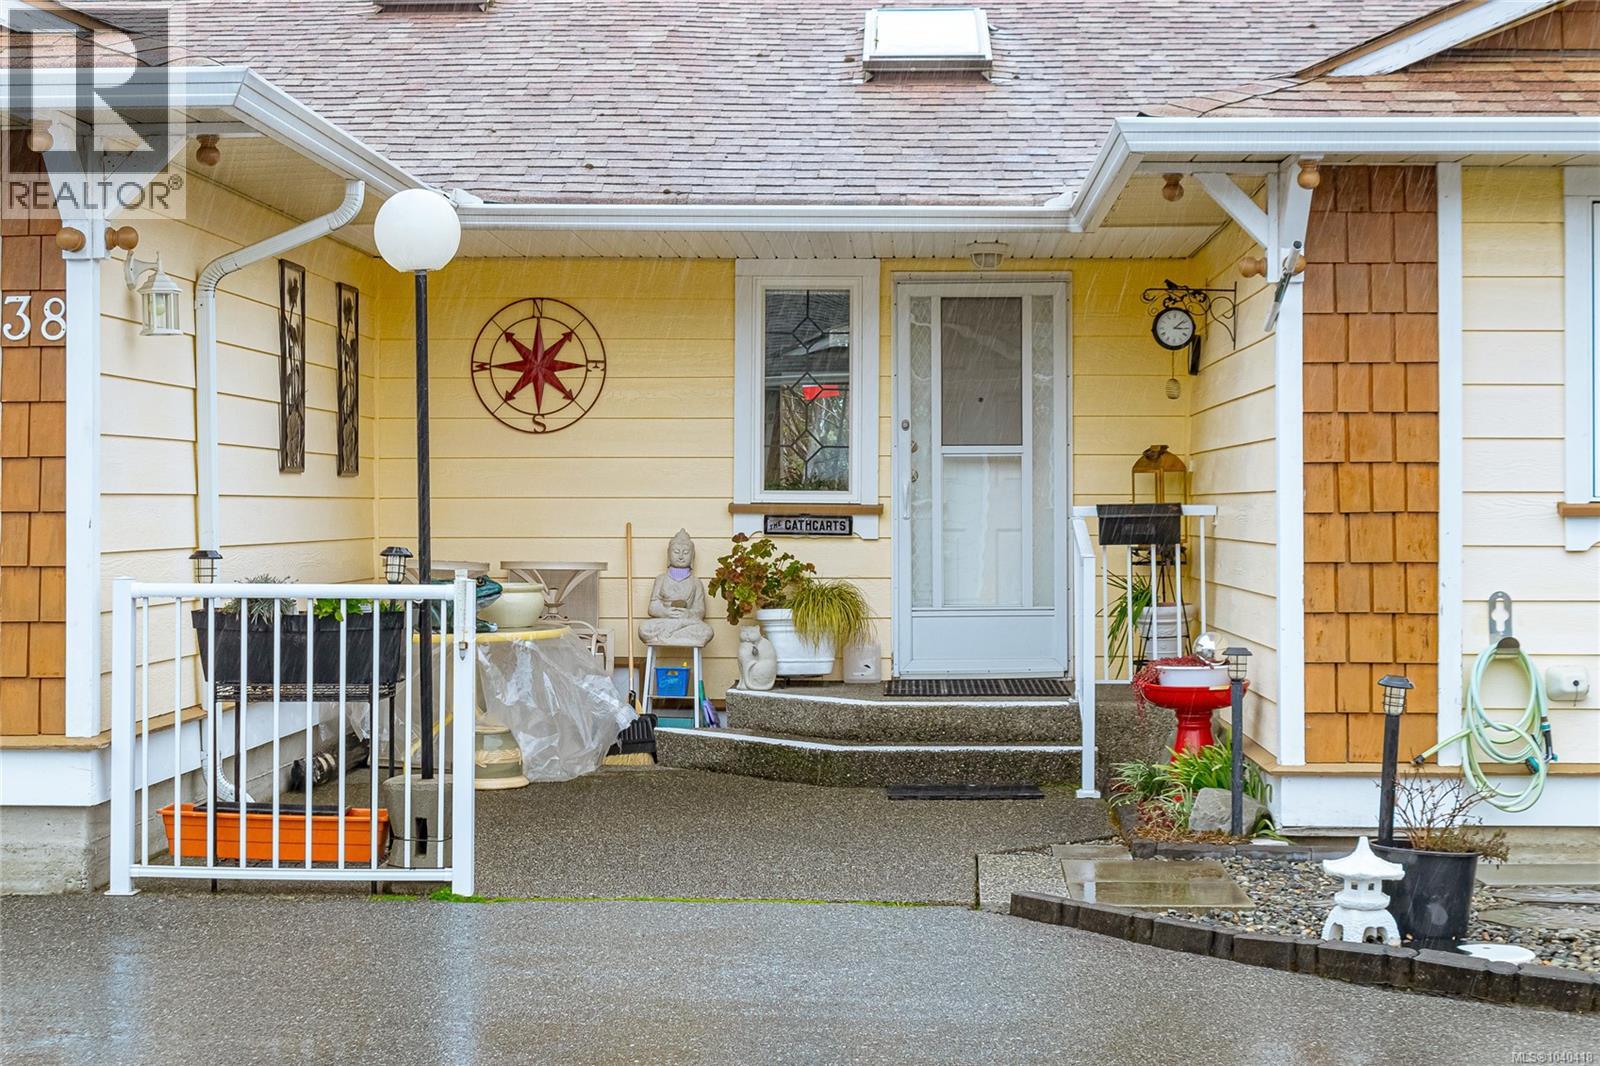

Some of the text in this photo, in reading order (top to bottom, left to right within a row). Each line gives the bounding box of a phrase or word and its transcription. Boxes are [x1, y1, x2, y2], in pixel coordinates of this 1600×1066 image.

[532, 298, 544, 318] N
[2, 295, 67, 341] 38
[586, 359, 606, 373] E
[532, 414, 547, 433] S
[769, 519, 846, 531] THE CATHCARTS
